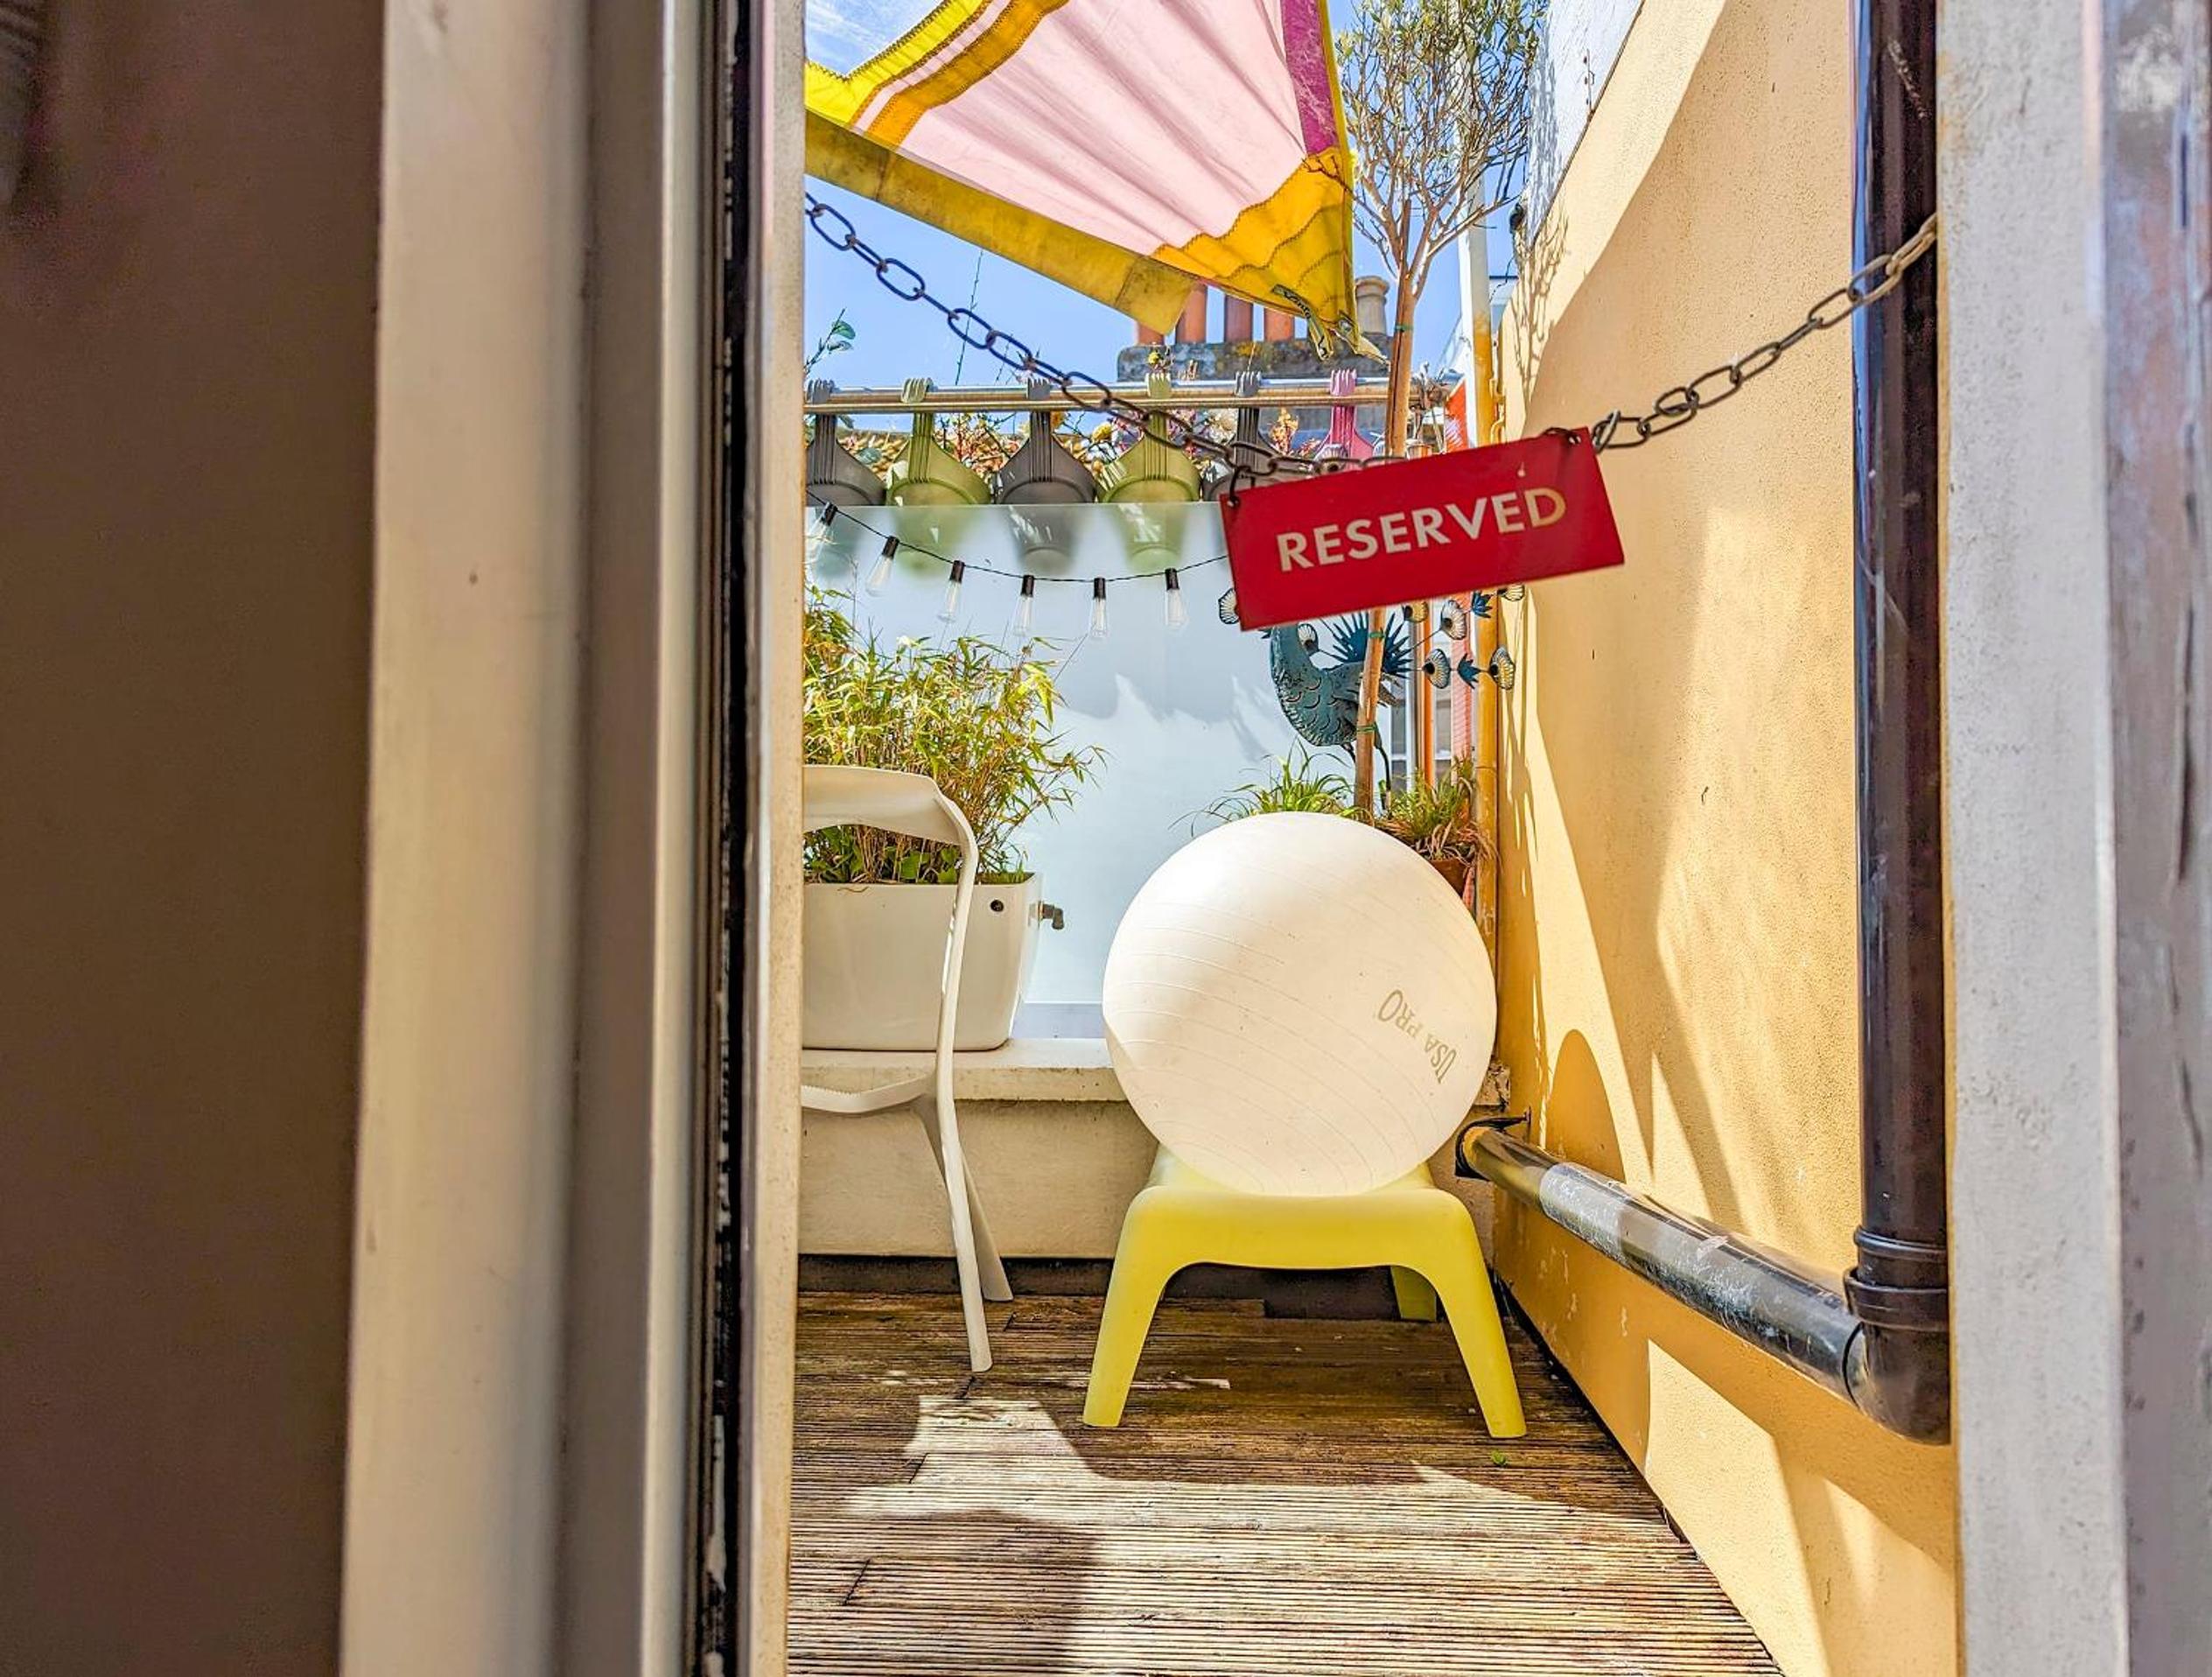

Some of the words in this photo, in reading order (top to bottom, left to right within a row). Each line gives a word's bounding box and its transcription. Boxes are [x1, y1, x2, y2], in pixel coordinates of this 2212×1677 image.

[1277, 487, 1567, 572] RESERVED
[1377, 989, 1424, 1039] PRO
[1424, 1033, 1457, 1084] USA
